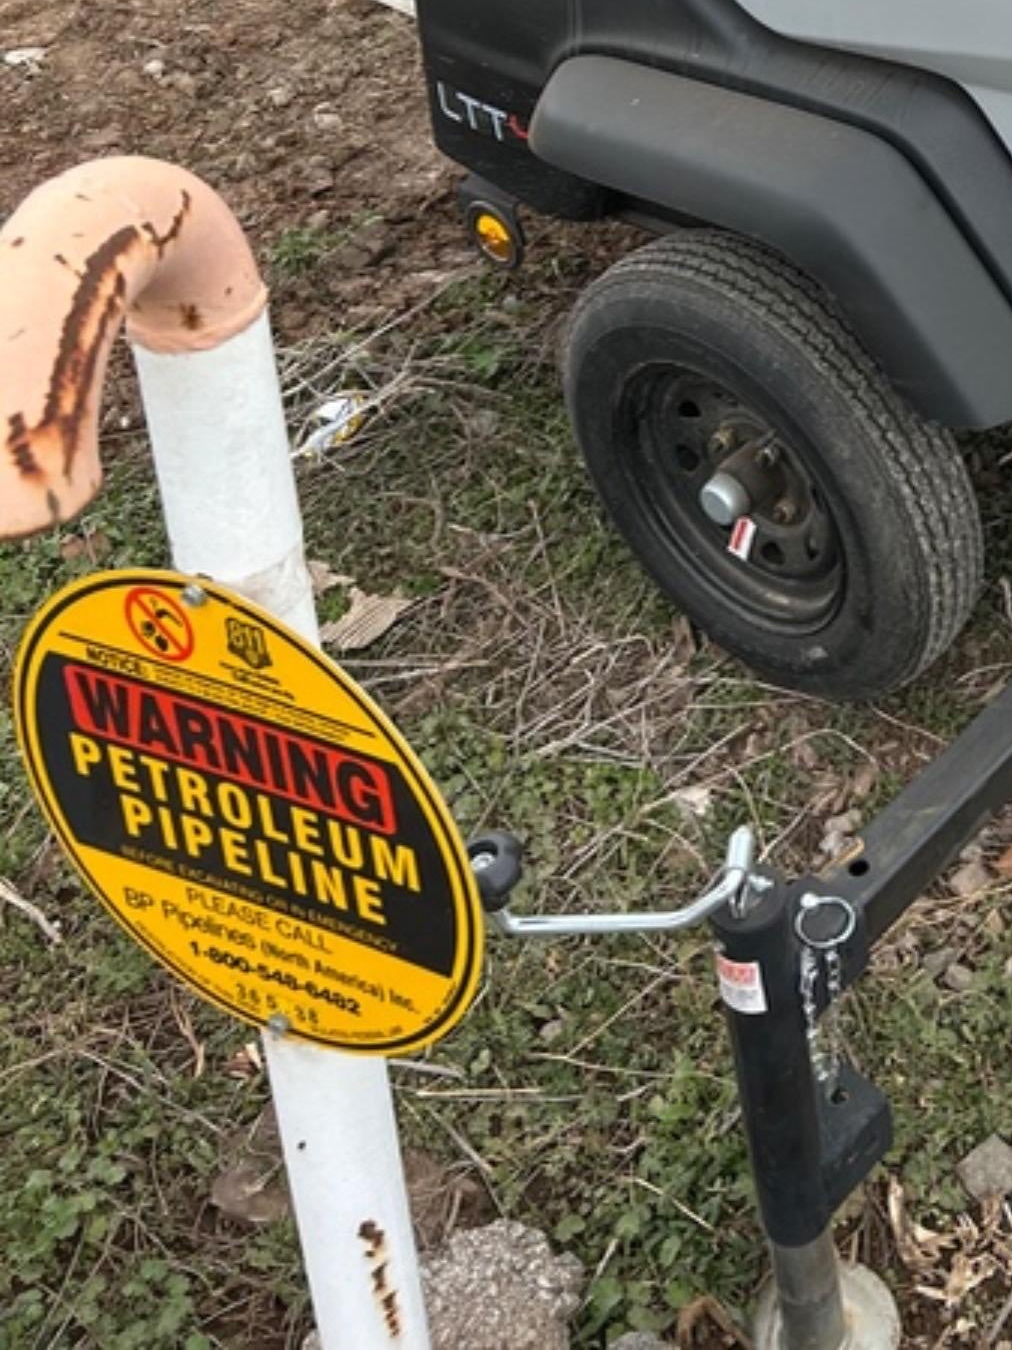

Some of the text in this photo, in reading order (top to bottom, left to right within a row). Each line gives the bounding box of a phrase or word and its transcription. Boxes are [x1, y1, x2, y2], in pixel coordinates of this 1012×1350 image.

[69, 732, 421, 892] PETROLEUM
[75, 671, 386, 828] WARNING
[121, 794, 387, 925] PIPELINE
[123, 886, 154, 910] BP
[160, 899, 257, 950] Pipelines
[186, 886, 332, 955] PLEASE CALL
